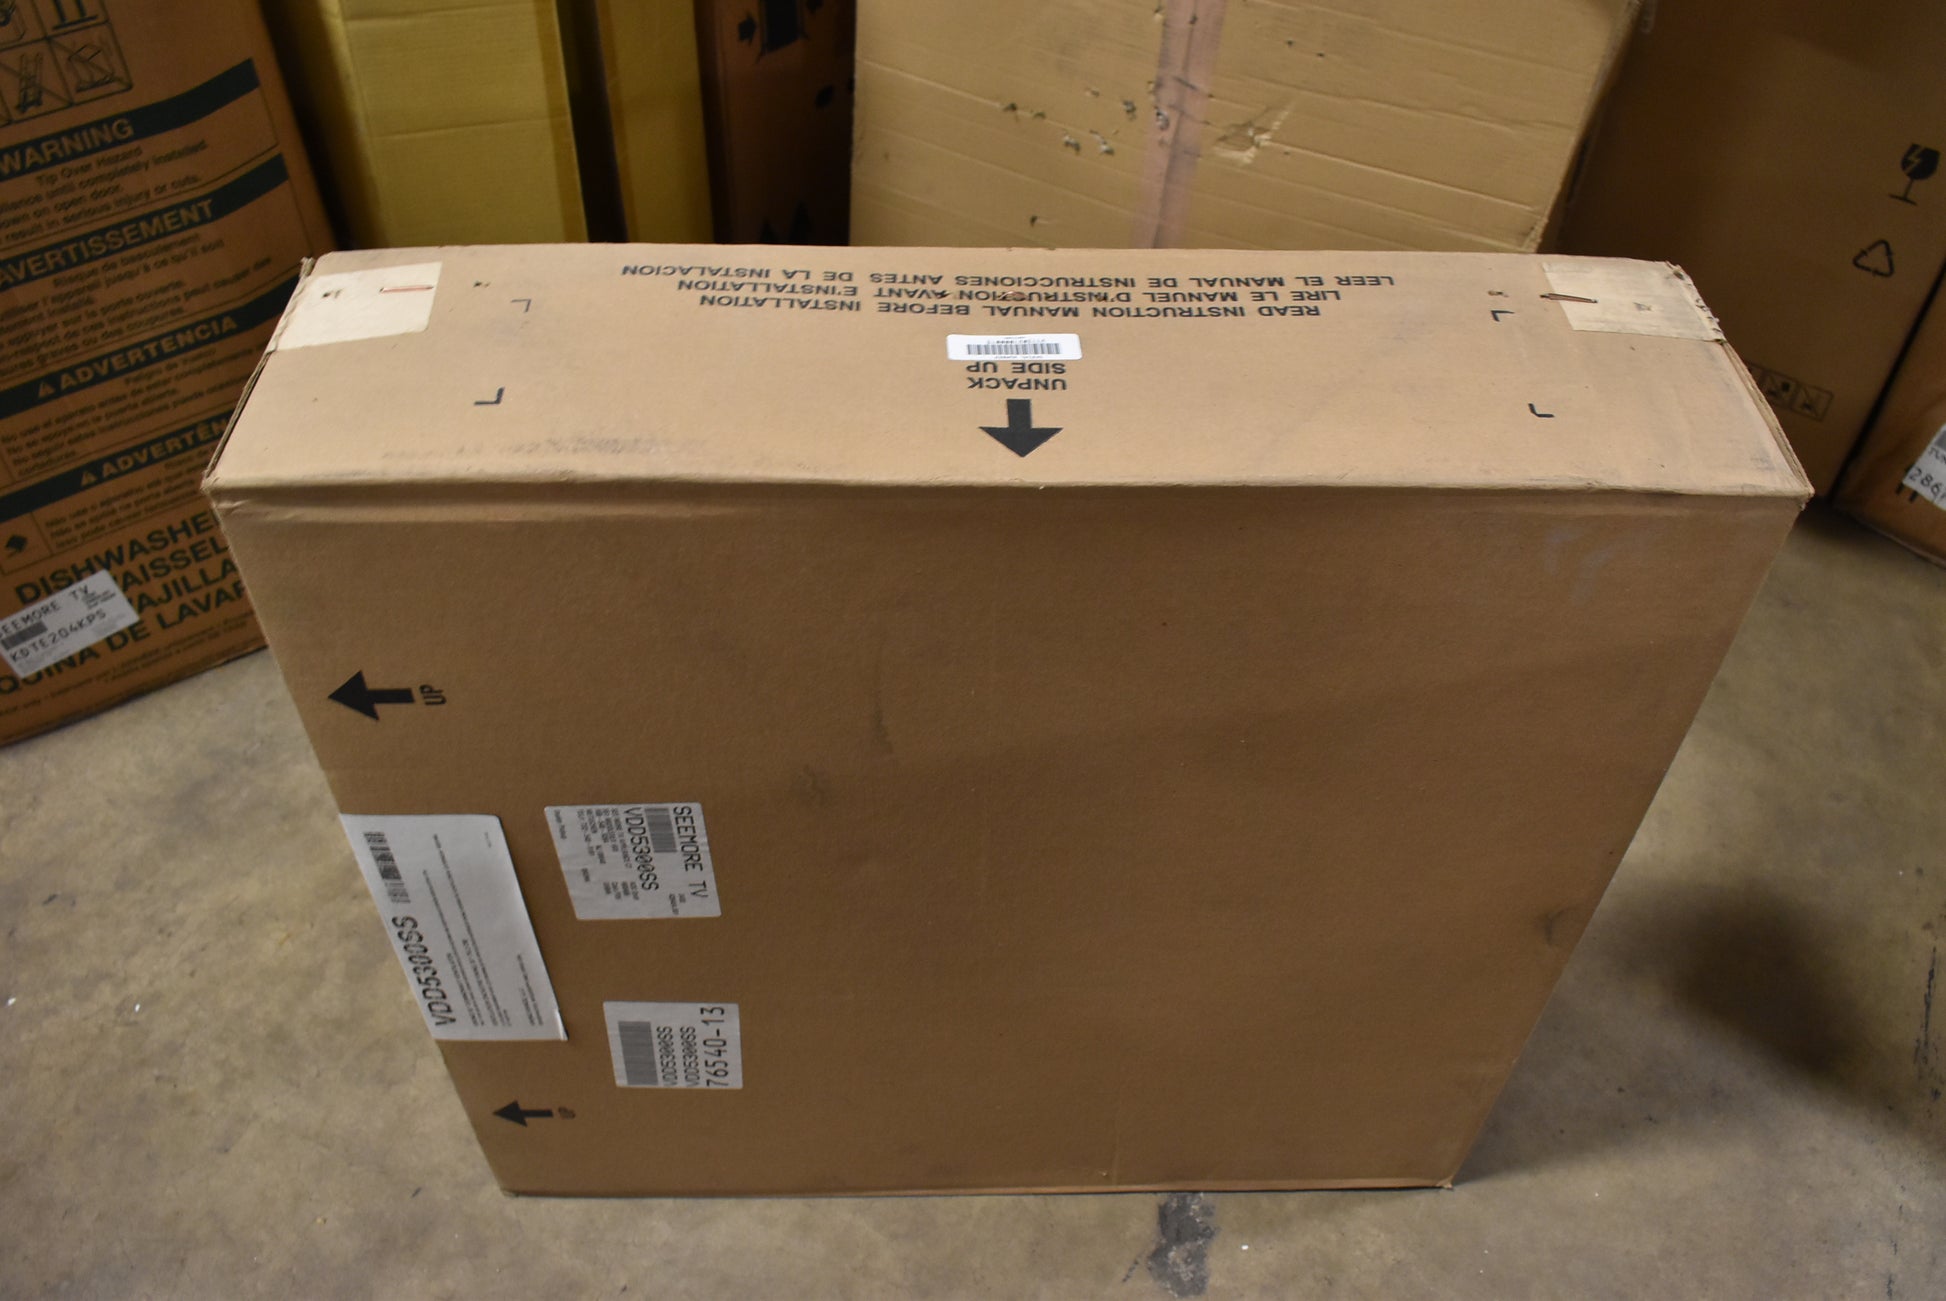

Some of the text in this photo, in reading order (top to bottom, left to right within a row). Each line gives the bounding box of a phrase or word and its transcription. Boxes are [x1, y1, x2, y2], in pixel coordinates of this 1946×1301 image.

[0, 118, 134, 175] WARNING
[0, 199, 213, 287] AVERTISSEMENT
[621, 264, 1394, 288] LEER EL MANUAL DE INSTRUCCIONES ANTES DE LA INSTALACION
[677, 279, 858, 297] E'INSTALLATION
[873, 287, 951, 300] AVANT
[700, 294, 1321, 318] READ INSTRUCTION MANUAL BEFORE INSTALLATION
[1141, 291, 1238, 303] MANUEL
[1250, 290, 1279, 302] LE
[1290, 290, 1341, 301] LIRE
[60, 316, 238, 391] ADVERTENCIA
[966, 360, 1067, 375] SIDE UP
[967, 376, 1067, 391] UNPACK
[15, 509, 219, 605] DISHWASHE
[113, 536, 230, 592] AISSEL
[128, 558, 238, 614] AJILLA
[0, 600, 60, 639] EEMORE
[105, 620, 151, 653] DE
[419, 684, 447, 706] UP
[622, 806, 660, 892] VDD5300SS
[672, 805, 704, 873] SEEMORE
[688, 879, 710, 899] TV
[391, 915, 457, 1027] VDD5300SS
[699, 1005, 729, 1088] 76540-13
